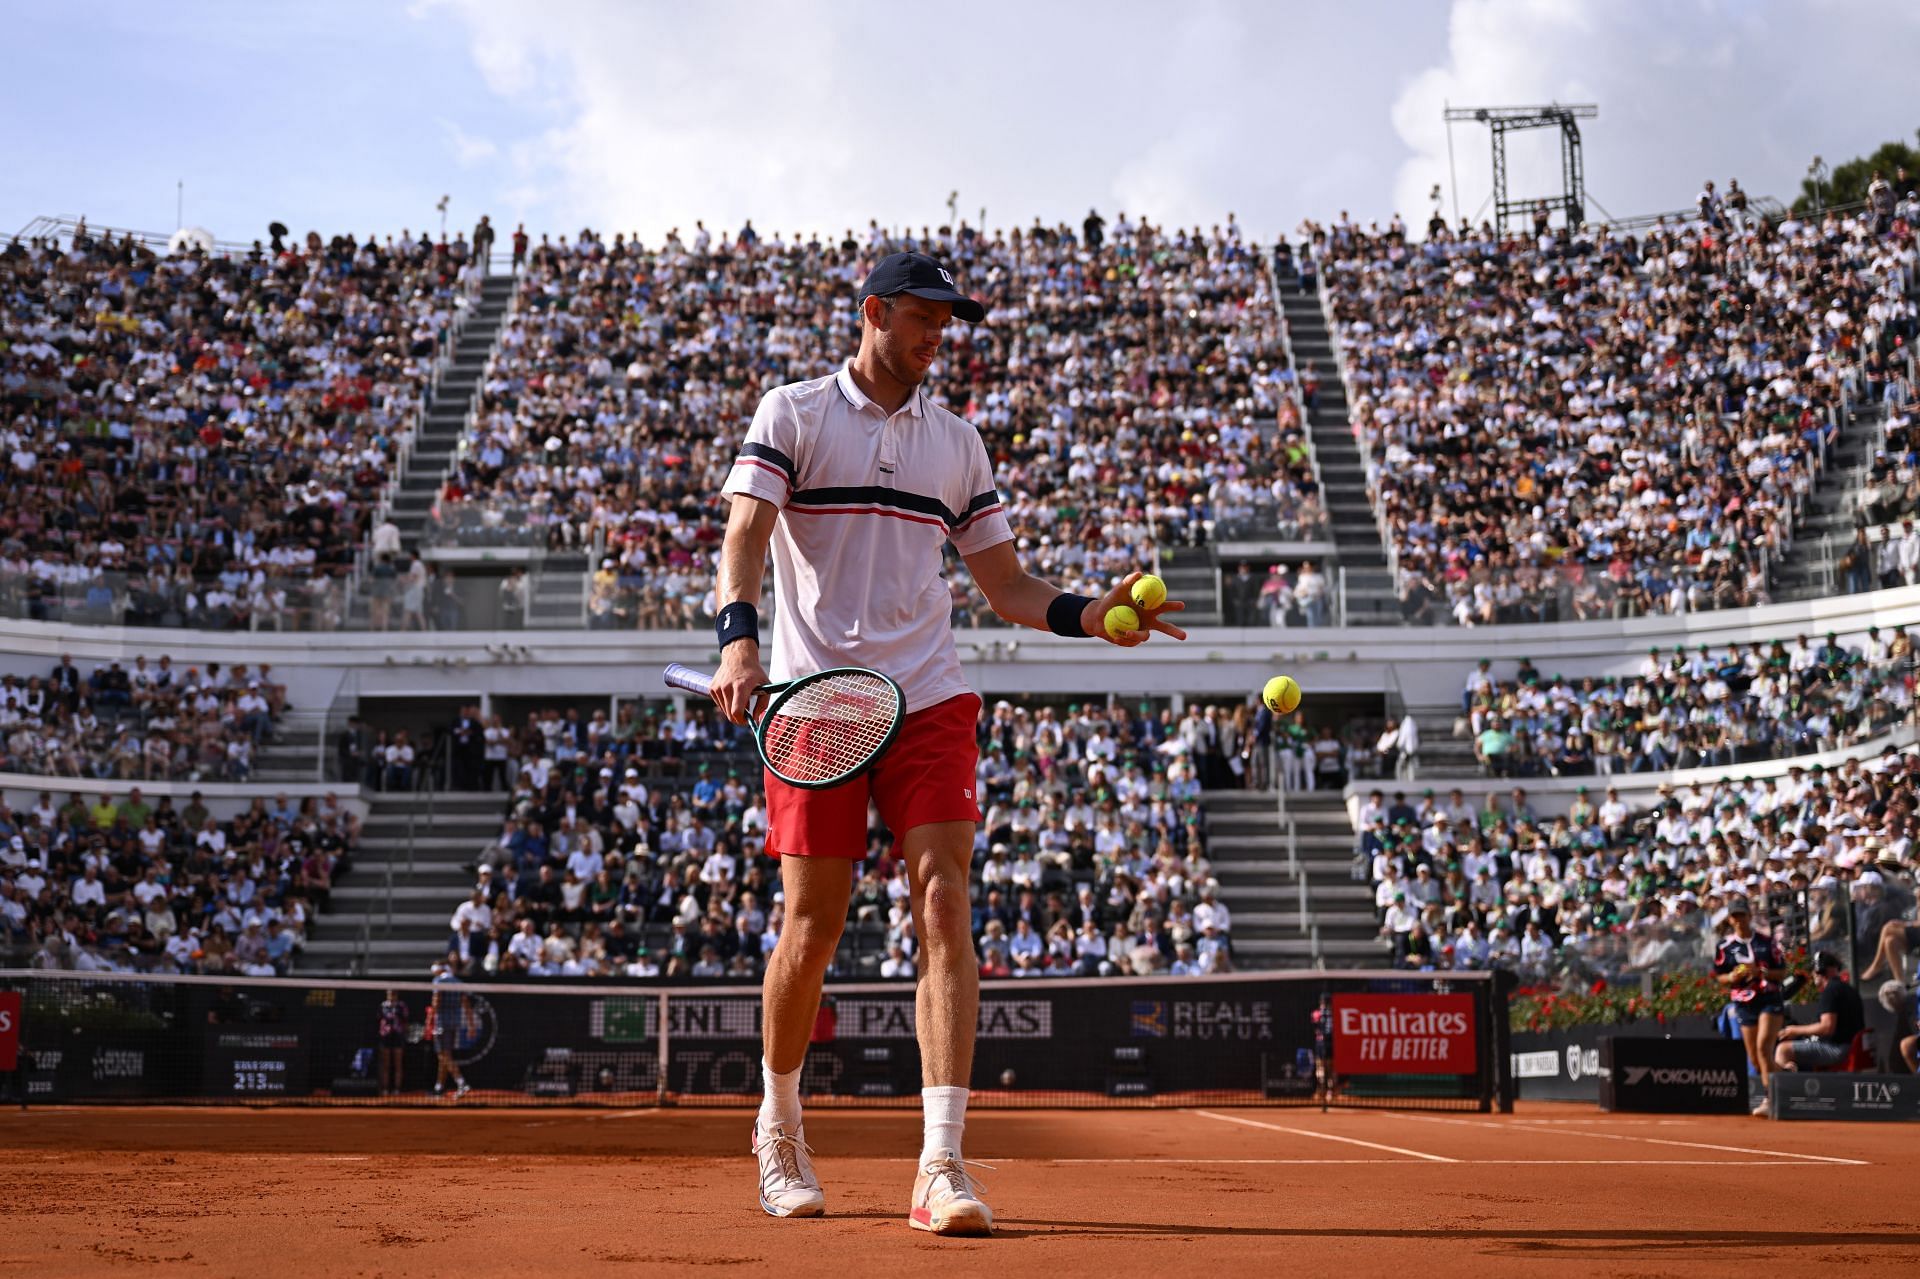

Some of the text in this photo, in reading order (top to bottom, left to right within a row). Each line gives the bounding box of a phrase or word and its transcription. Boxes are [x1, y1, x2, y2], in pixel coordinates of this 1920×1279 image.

[1173, 1001, 1272, 1023] REALE
[1340, 1007, 1467, 1036] Emirates
[1173, 1024, 1272, 1039] MUTUA
[1360, 1038, 1449, 1061] FLY BETTER
[675, 1051, 844, 1094] TOR
[1649, 1068, 1739, 1085] YOKOHAMA
[1701, 1086, 1739, 1098] TYRES
[1852, 1081, 1893, 1102] ITA
